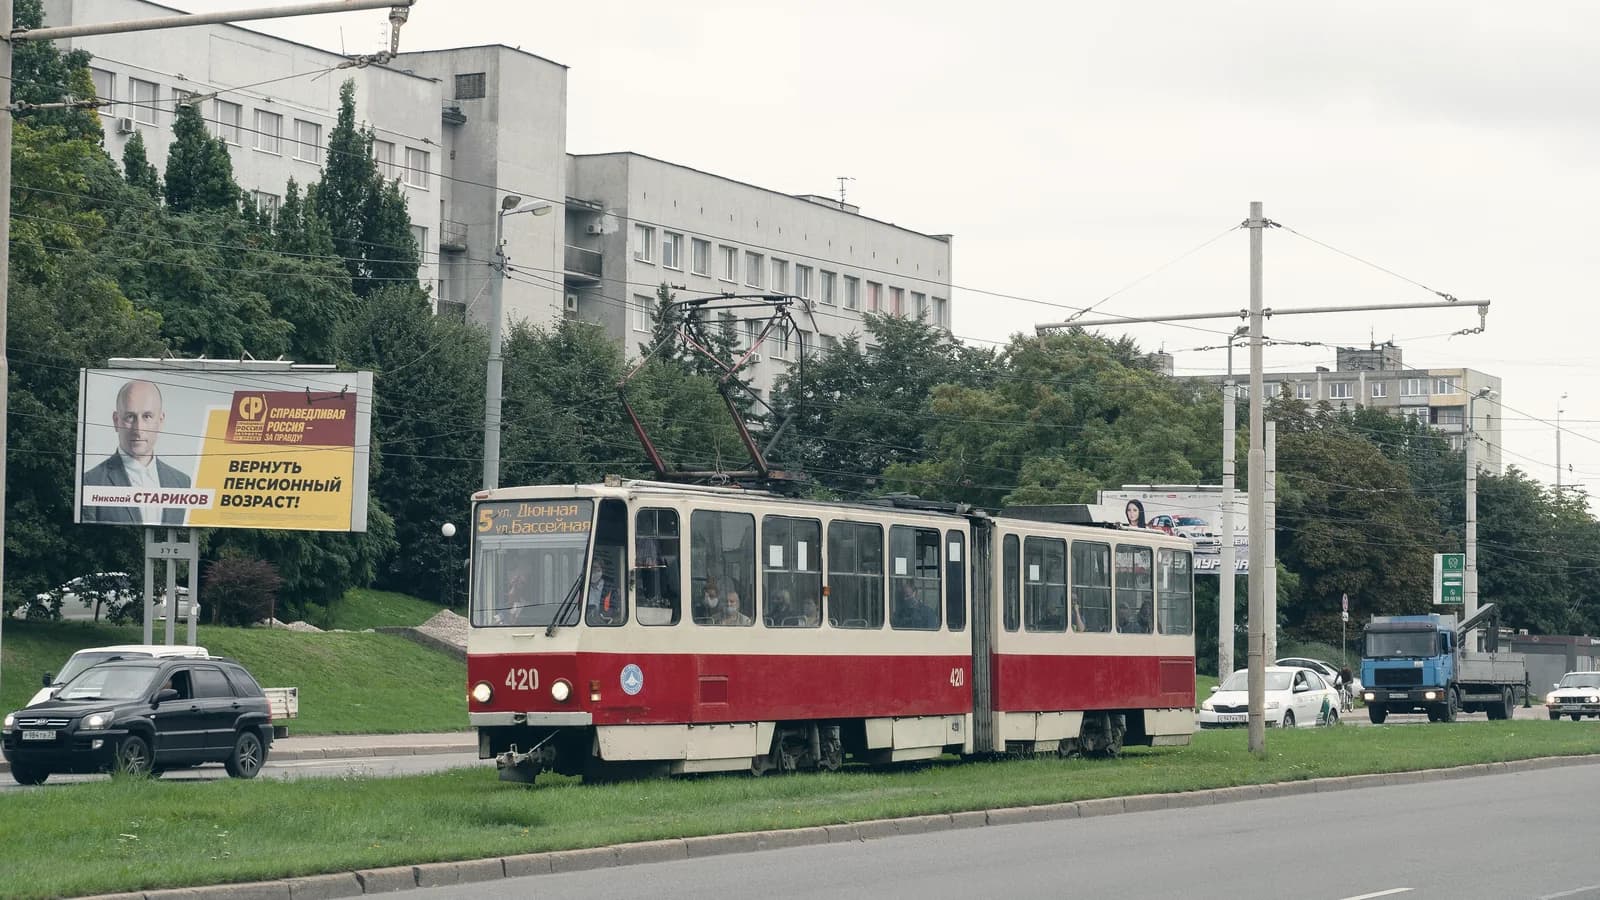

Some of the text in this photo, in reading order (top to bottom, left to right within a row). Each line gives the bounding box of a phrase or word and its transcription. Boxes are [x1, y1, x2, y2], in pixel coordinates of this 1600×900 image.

[270, 407, 346, 421] СПРАВЕДЛИВАЯ
[266, 421, 305, 433] РОССИЯ
[228, 460, 302, 474] ВЕРНУТЬ
[223, 476, 342, 493] ПЕНСИОННЫЙ
[91, 492, 209, 505] Николай СТАРИКОВ
[220, 495, 300, 508] ВОЗРАСТ!
[517, 503, 578, 518] Дюнная
[478, 509, 494, 532] 5
[505, 668, 539, 691] 420
[949, 667, 964, 687] 420
